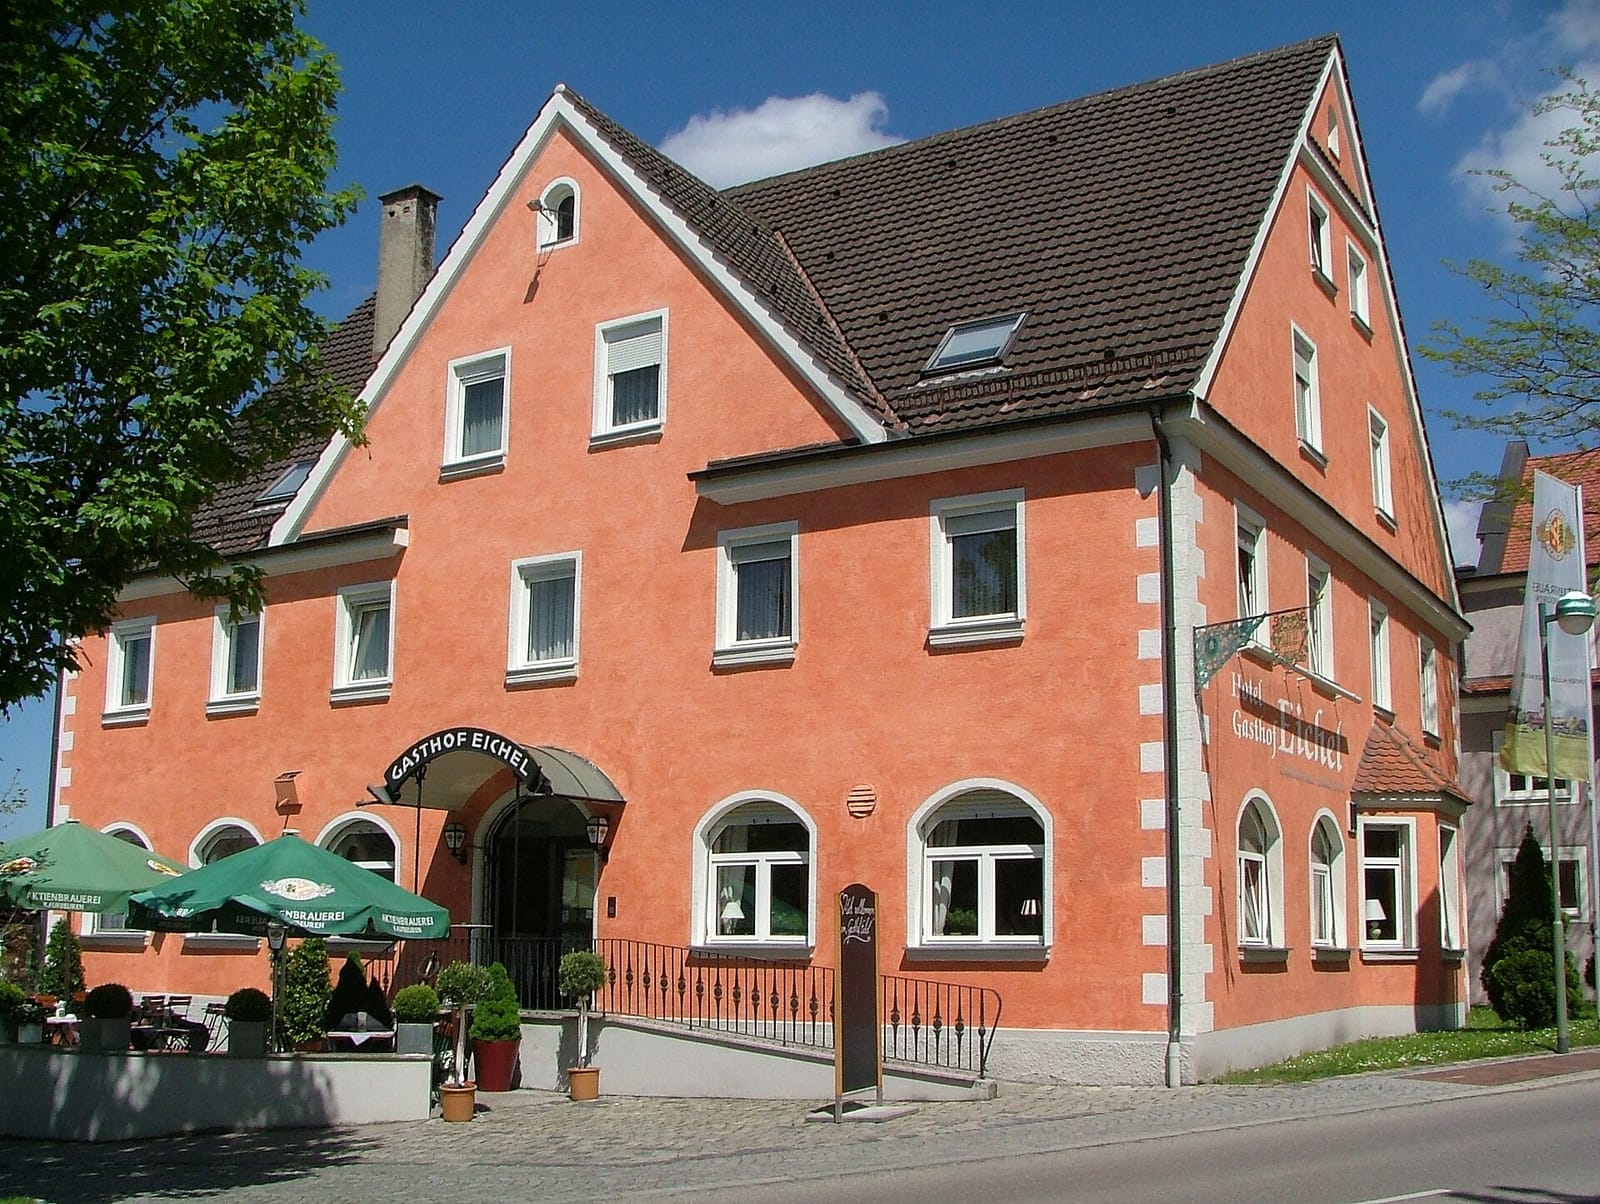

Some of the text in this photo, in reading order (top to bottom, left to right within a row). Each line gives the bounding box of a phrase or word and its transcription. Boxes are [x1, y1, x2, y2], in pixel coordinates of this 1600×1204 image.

[1231, 671, 1263, 706] Hotel
[391, 731, 529, 780] GASTHOF EICHEL
[1232, 698, 1343, 773] Gasthof Eichel
[26, 891, 101, 904] AKTIENBRAUEREI
